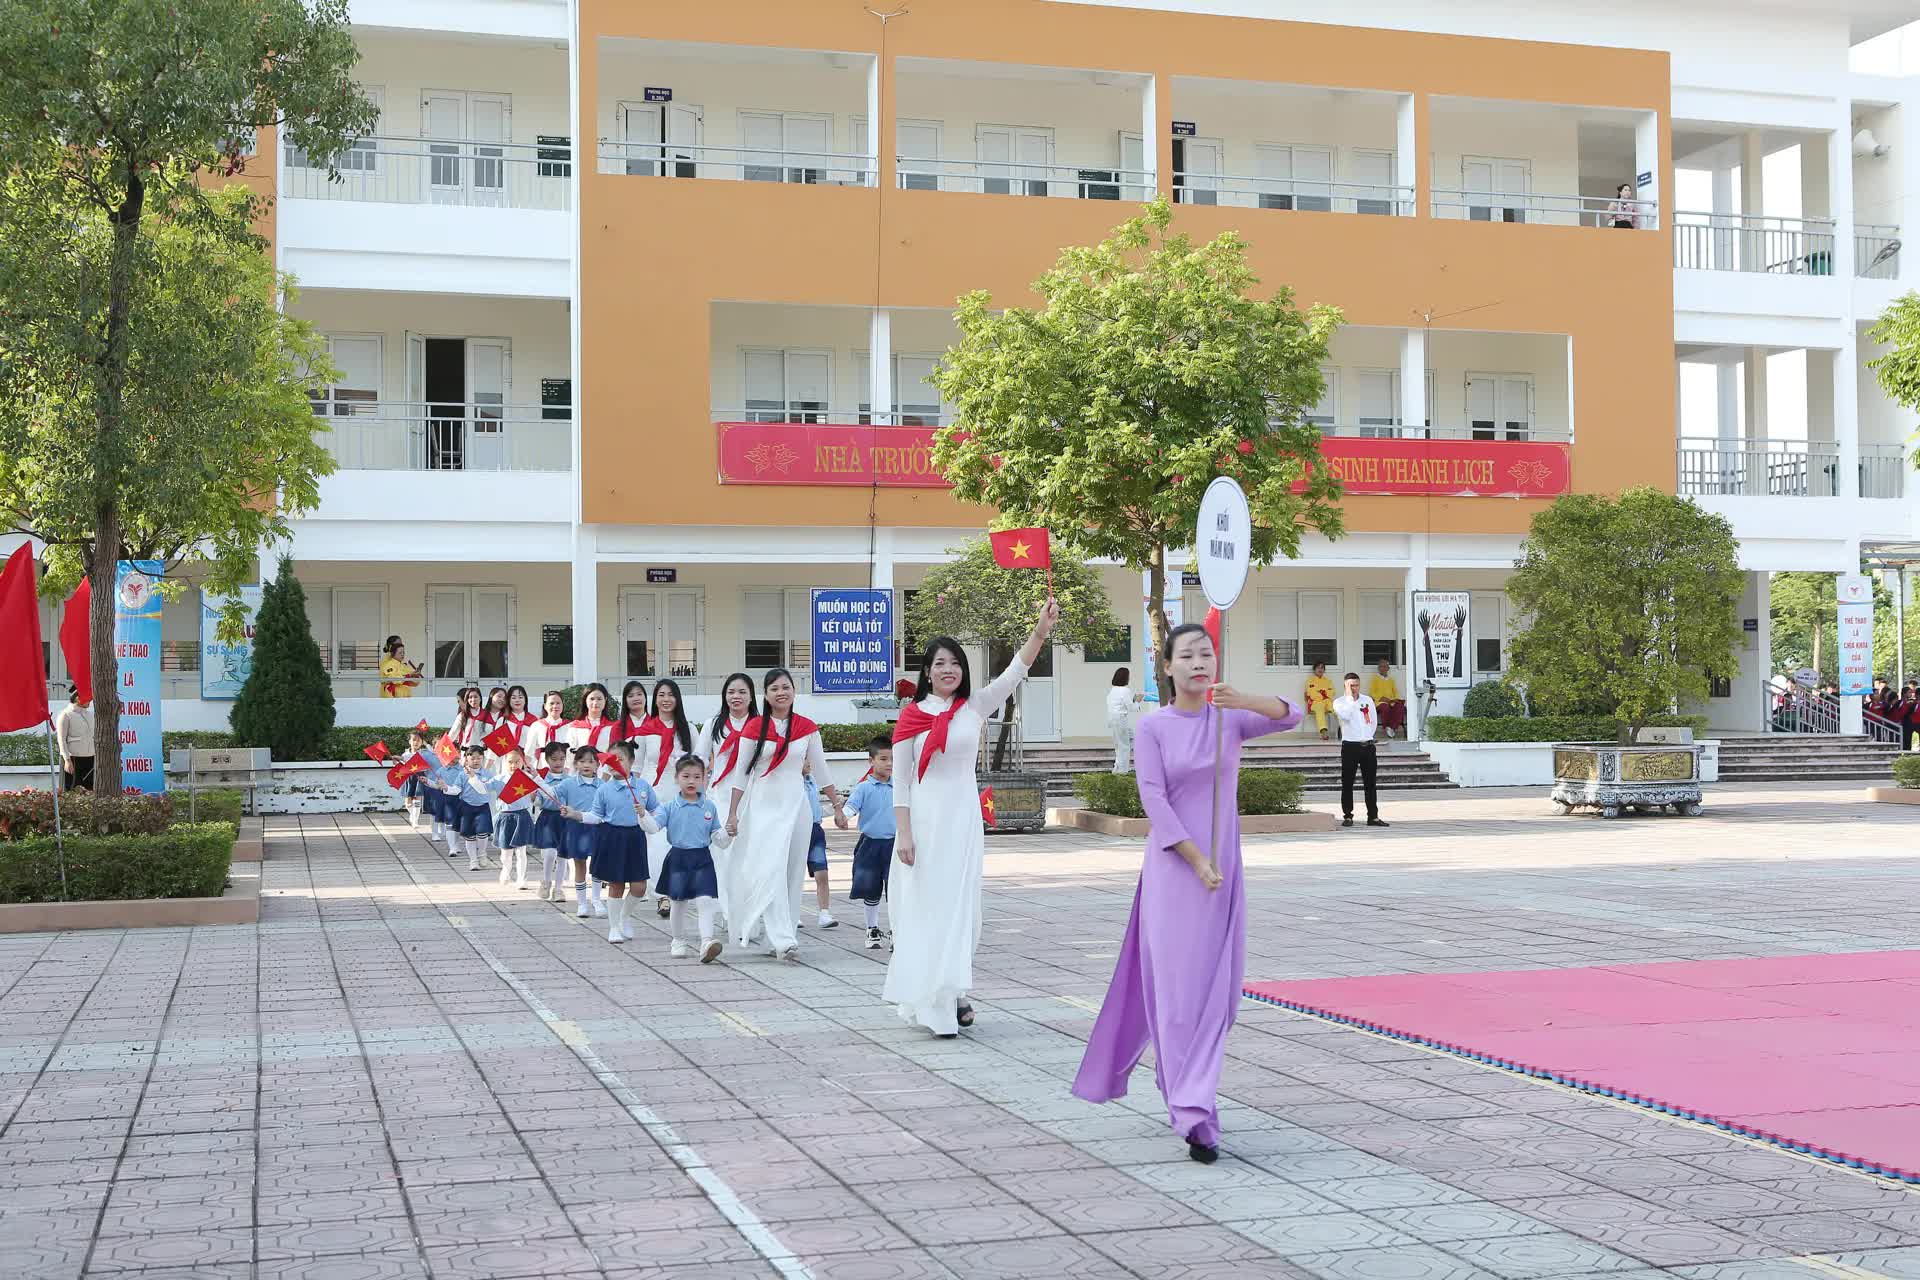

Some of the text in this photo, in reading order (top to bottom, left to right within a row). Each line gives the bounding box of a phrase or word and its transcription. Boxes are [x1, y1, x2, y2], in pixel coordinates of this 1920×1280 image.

[814, 435, 864, 473] NHÀ
[1332, 457, 1379, 483] SINH
[1383, 458, 1450, 484] THANH
[1223, 541, 1235, 560] NON
[817, 597, 887, 616] MUỐN HỌC CÓ
[821, 617, 883, 635] KẾT QUẢ TỐT
[128, 644, 149, 658] THAO
[823, 637, 882, 653] THÌ PHẢI CÓ
[818, 658, 887, 676] THÁI ĐỘ ĐÚNG
[123, 671, 134, 687] LÀ
[127, 699, 151, 716] KHÓA
[119, 726, 137, 744] CỦA
[126, 755, 153, 772] KHỎE!
